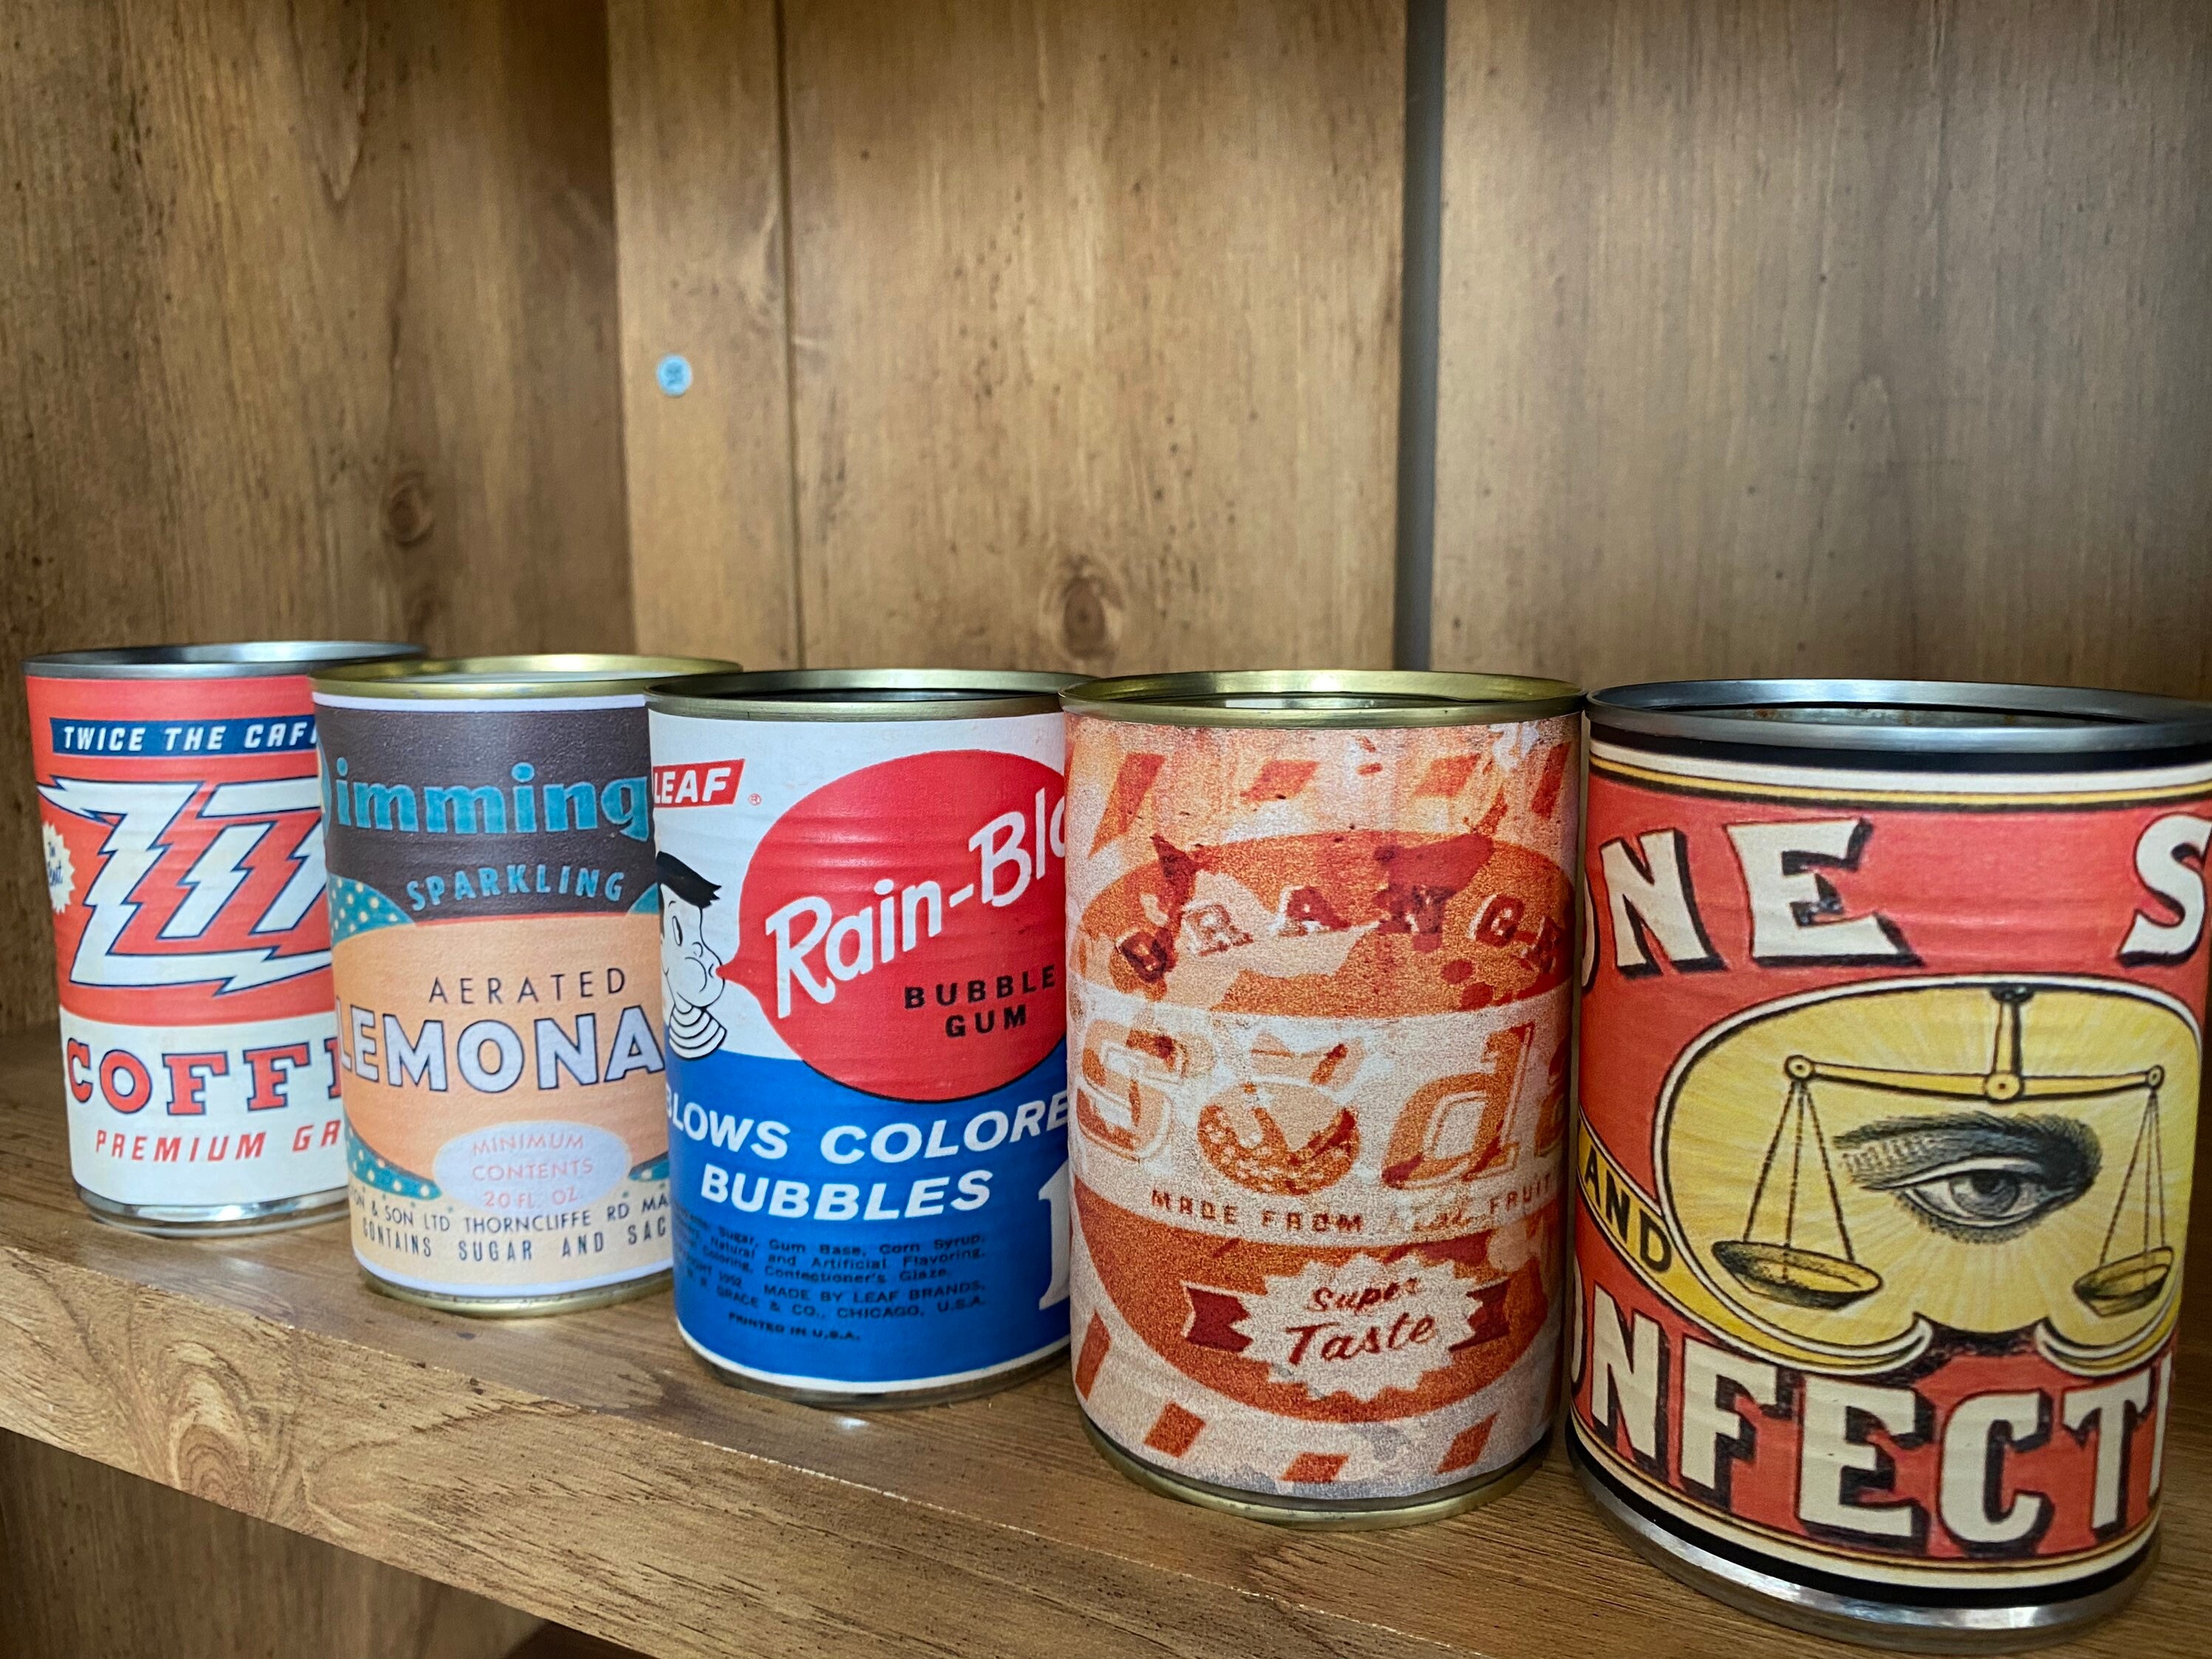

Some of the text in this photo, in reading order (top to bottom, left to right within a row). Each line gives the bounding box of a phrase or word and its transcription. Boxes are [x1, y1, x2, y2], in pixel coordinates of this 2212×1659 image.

[64, 725, 147, 752] TWICE
[163, 725, 227, 751] THE
[654, 767, 732, 804] LEAF
[406, 864, 625, 912] SPARKLING
[1580, 816, 1924, 994] NE
[428, 966, 626, 1005] AERATED
[903, 964, 1057, 1010] BUBBLE
[945, 1002, 1028, 1039] GUM
[336, 995, 666, 1093] LEMONA
[95, 1128, 268, 1163] PREMIUM
[472, 1133, 584, 1156] MINIMUM
[472, 1157, 594, 1181] CONTENTS
[484, 1190, 512, 1209] 20
[700, 1163, 994, 1222] BUBBLES
[1150, 1188, 1238, 1225] MADE
[1260, 1209, 1363, 1233] FROM
[1584, 1143, 1672, 1273] AND
[384, 1204, 414, 1227] SON
[424, 1213, 451, 1232] LTD
[465, 1209, 591, 1234] THORNCLIFFE
[606, 1202, 631, 1222] RD
[362, 1216, 432, 1258] CONTAINS
[458, 1239, 533, 1262] SUGAR
[562, 1231, 605, 1257] AND
[768, 1238, 806, 1254] Gum
[878, 1243, 920, 1255] Corn
[767, 1254, 798, 1266] and
[810, 1257, 887, 1271] Artificial
[763, 1283, 811, 1301] MADE
[819, 1291, 844, 1303] BY
[852, 1289, 899, 1304] LEAF
[769, 1300, 781, 1313] &
[727, 1312, 785, 1333] PRINTED
[790, 1326, 807, 1336] IN
[1285, 1312, 1438, 1368] Taste
